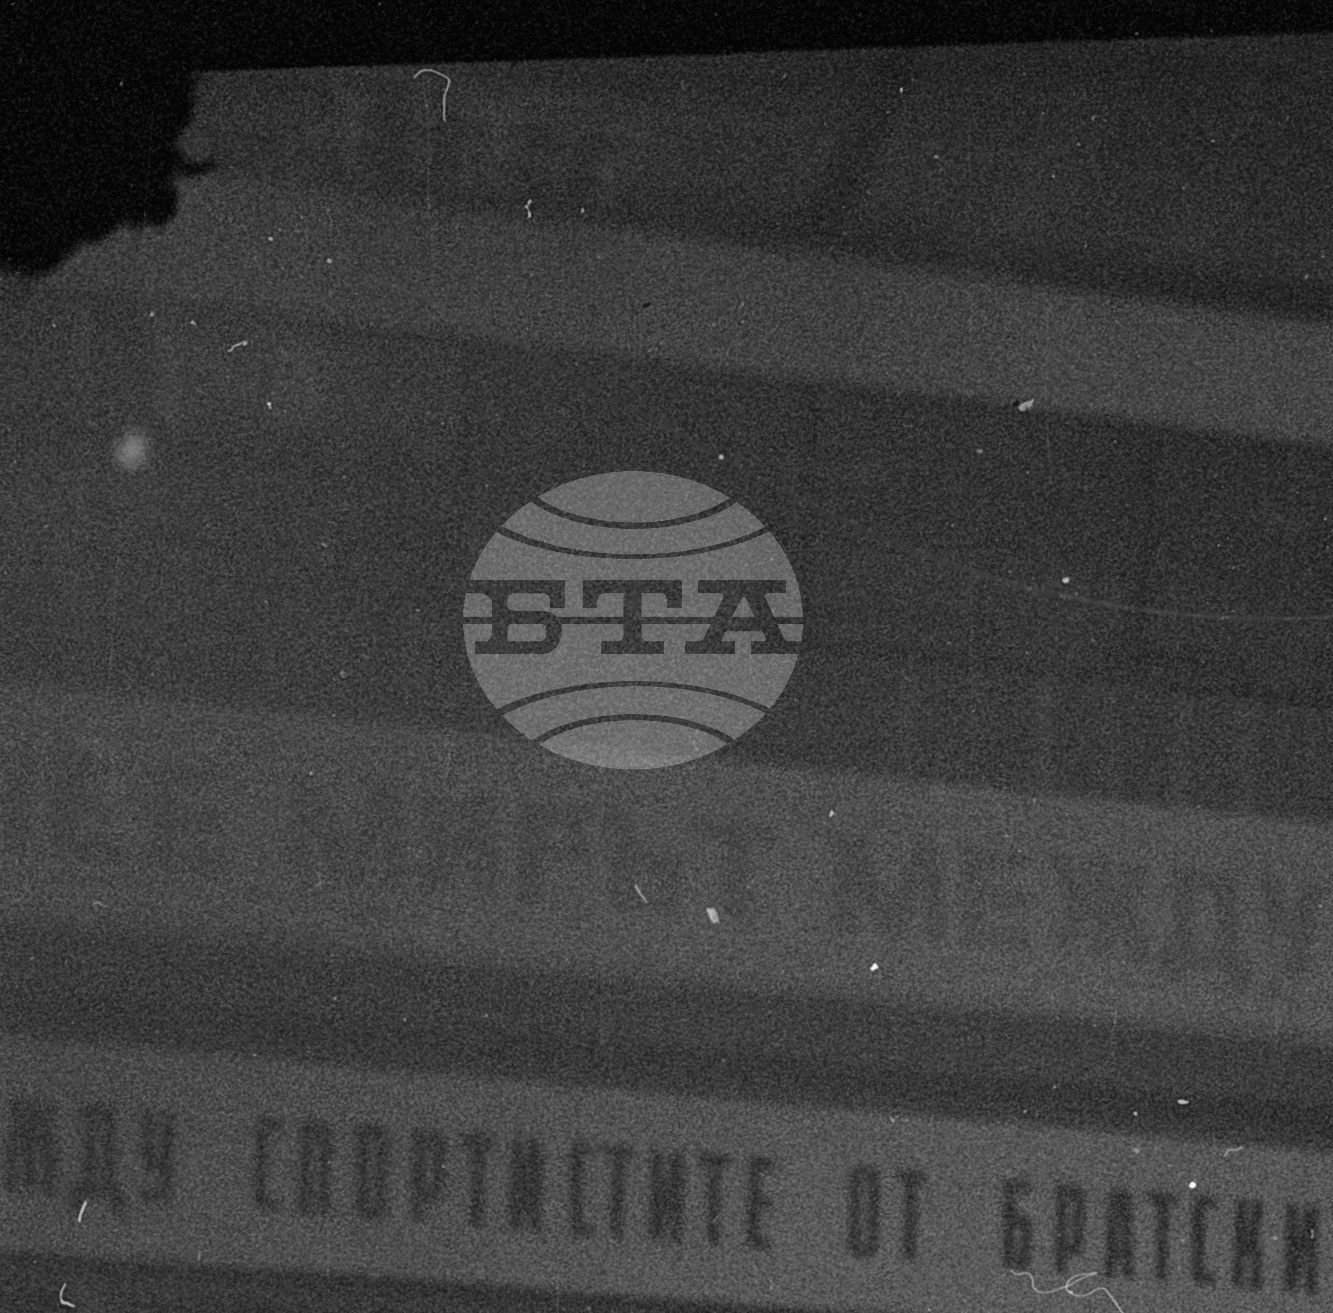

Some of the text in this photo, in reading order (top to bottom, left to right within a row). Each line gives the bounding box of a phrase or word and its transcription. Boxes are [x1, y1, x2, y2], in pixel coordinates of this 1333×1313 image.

[828, 828, 1325, 985] МЕЖДУ
[252, 1112, 775, 1252] СПОРТИСТИТЕ
[843, 1160, 930, 1262] ОТ
